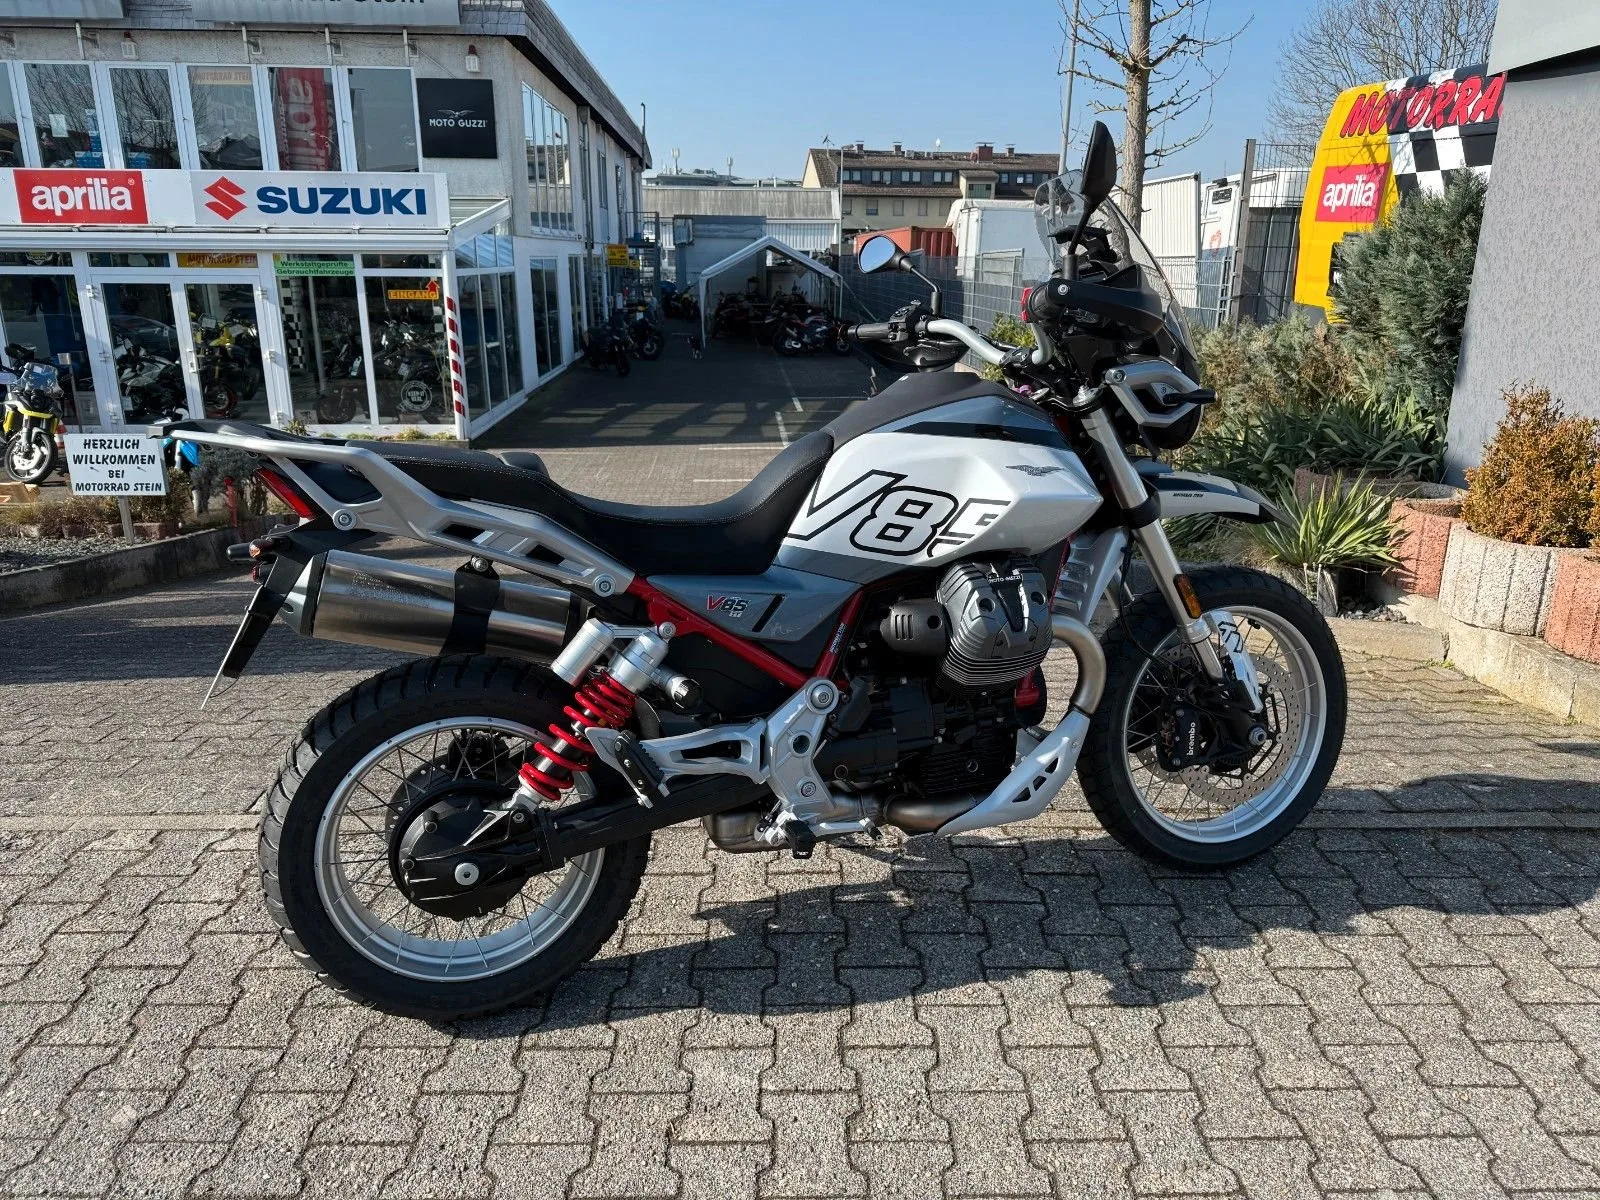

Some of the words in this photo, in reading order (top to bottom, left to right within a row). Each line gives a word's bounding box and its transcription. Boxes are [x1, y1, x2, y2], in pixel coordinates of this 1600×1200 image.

[1340, 71, 1507, 138] MOTORRA
[429, 119, 455, 127] MOTO
[458, 119, 486, 128] GUZZI
[31, 177, 133, 217] aprilia
[256, 186, 427, 216] SUZUKI
[1322, 174, 1376, 213] aprilia
[83, 439, 140, 449] HERZLICH
[73, 454, 156, 465] WILLKOMMEN
[108, 469, 125, 478] BEI
[75, 482, 130, 492] MOTORRAD
[133, 482, 162, 492] STEIN
[707, 594, 751, 612] V85
[1187, 722, 1196, 756] brembo
